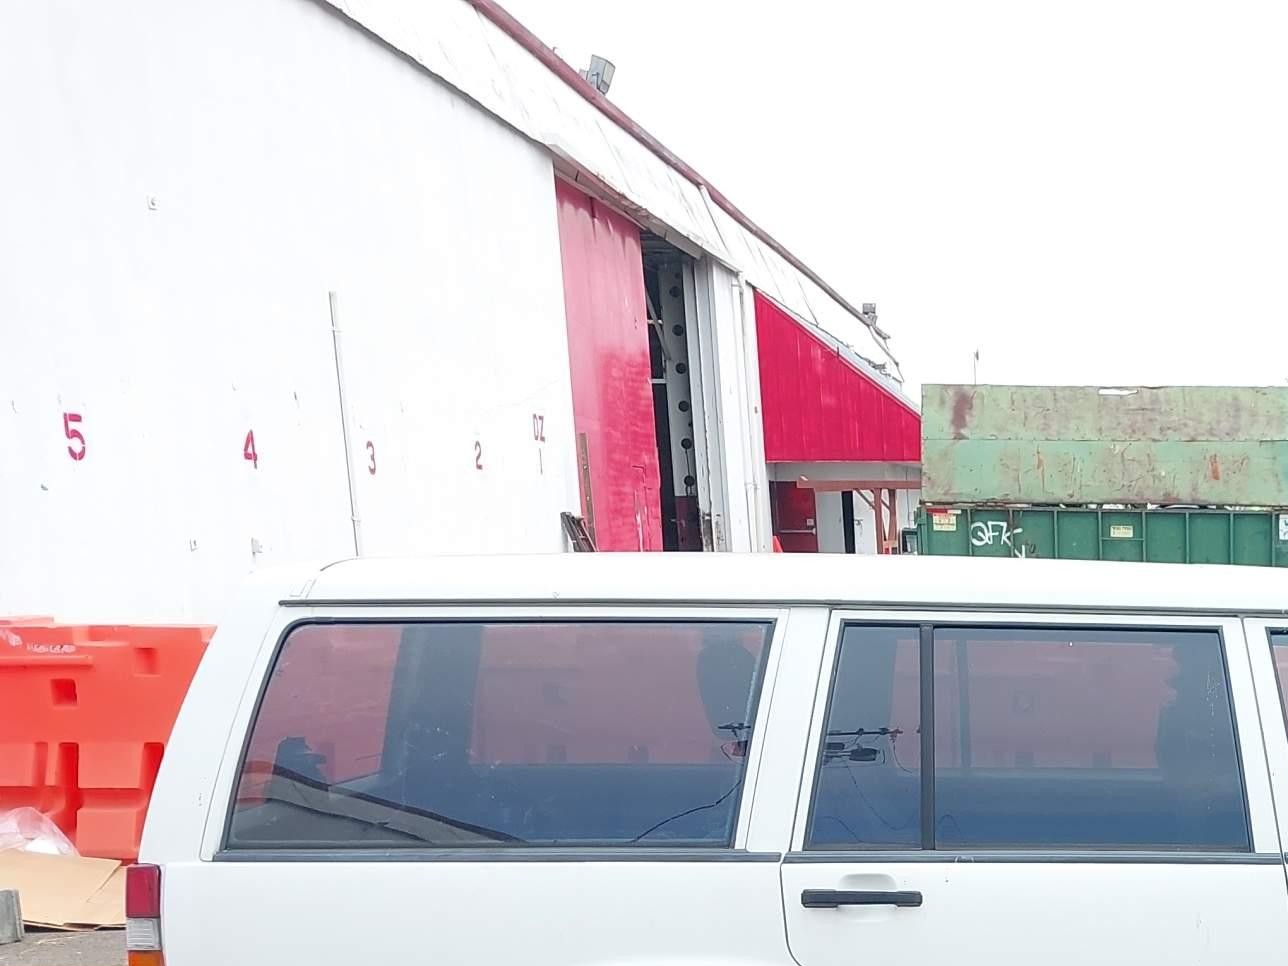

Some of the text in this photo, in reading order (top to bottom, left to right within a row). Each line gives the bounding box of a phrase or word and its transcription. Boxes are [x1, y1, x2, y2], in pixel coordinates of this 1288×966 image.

[63, 412, 86, 461] 5
[242, 430, 259, 469] 4
[366, 440, 377, 475] 3
[474, 440, 484, 471] 2
